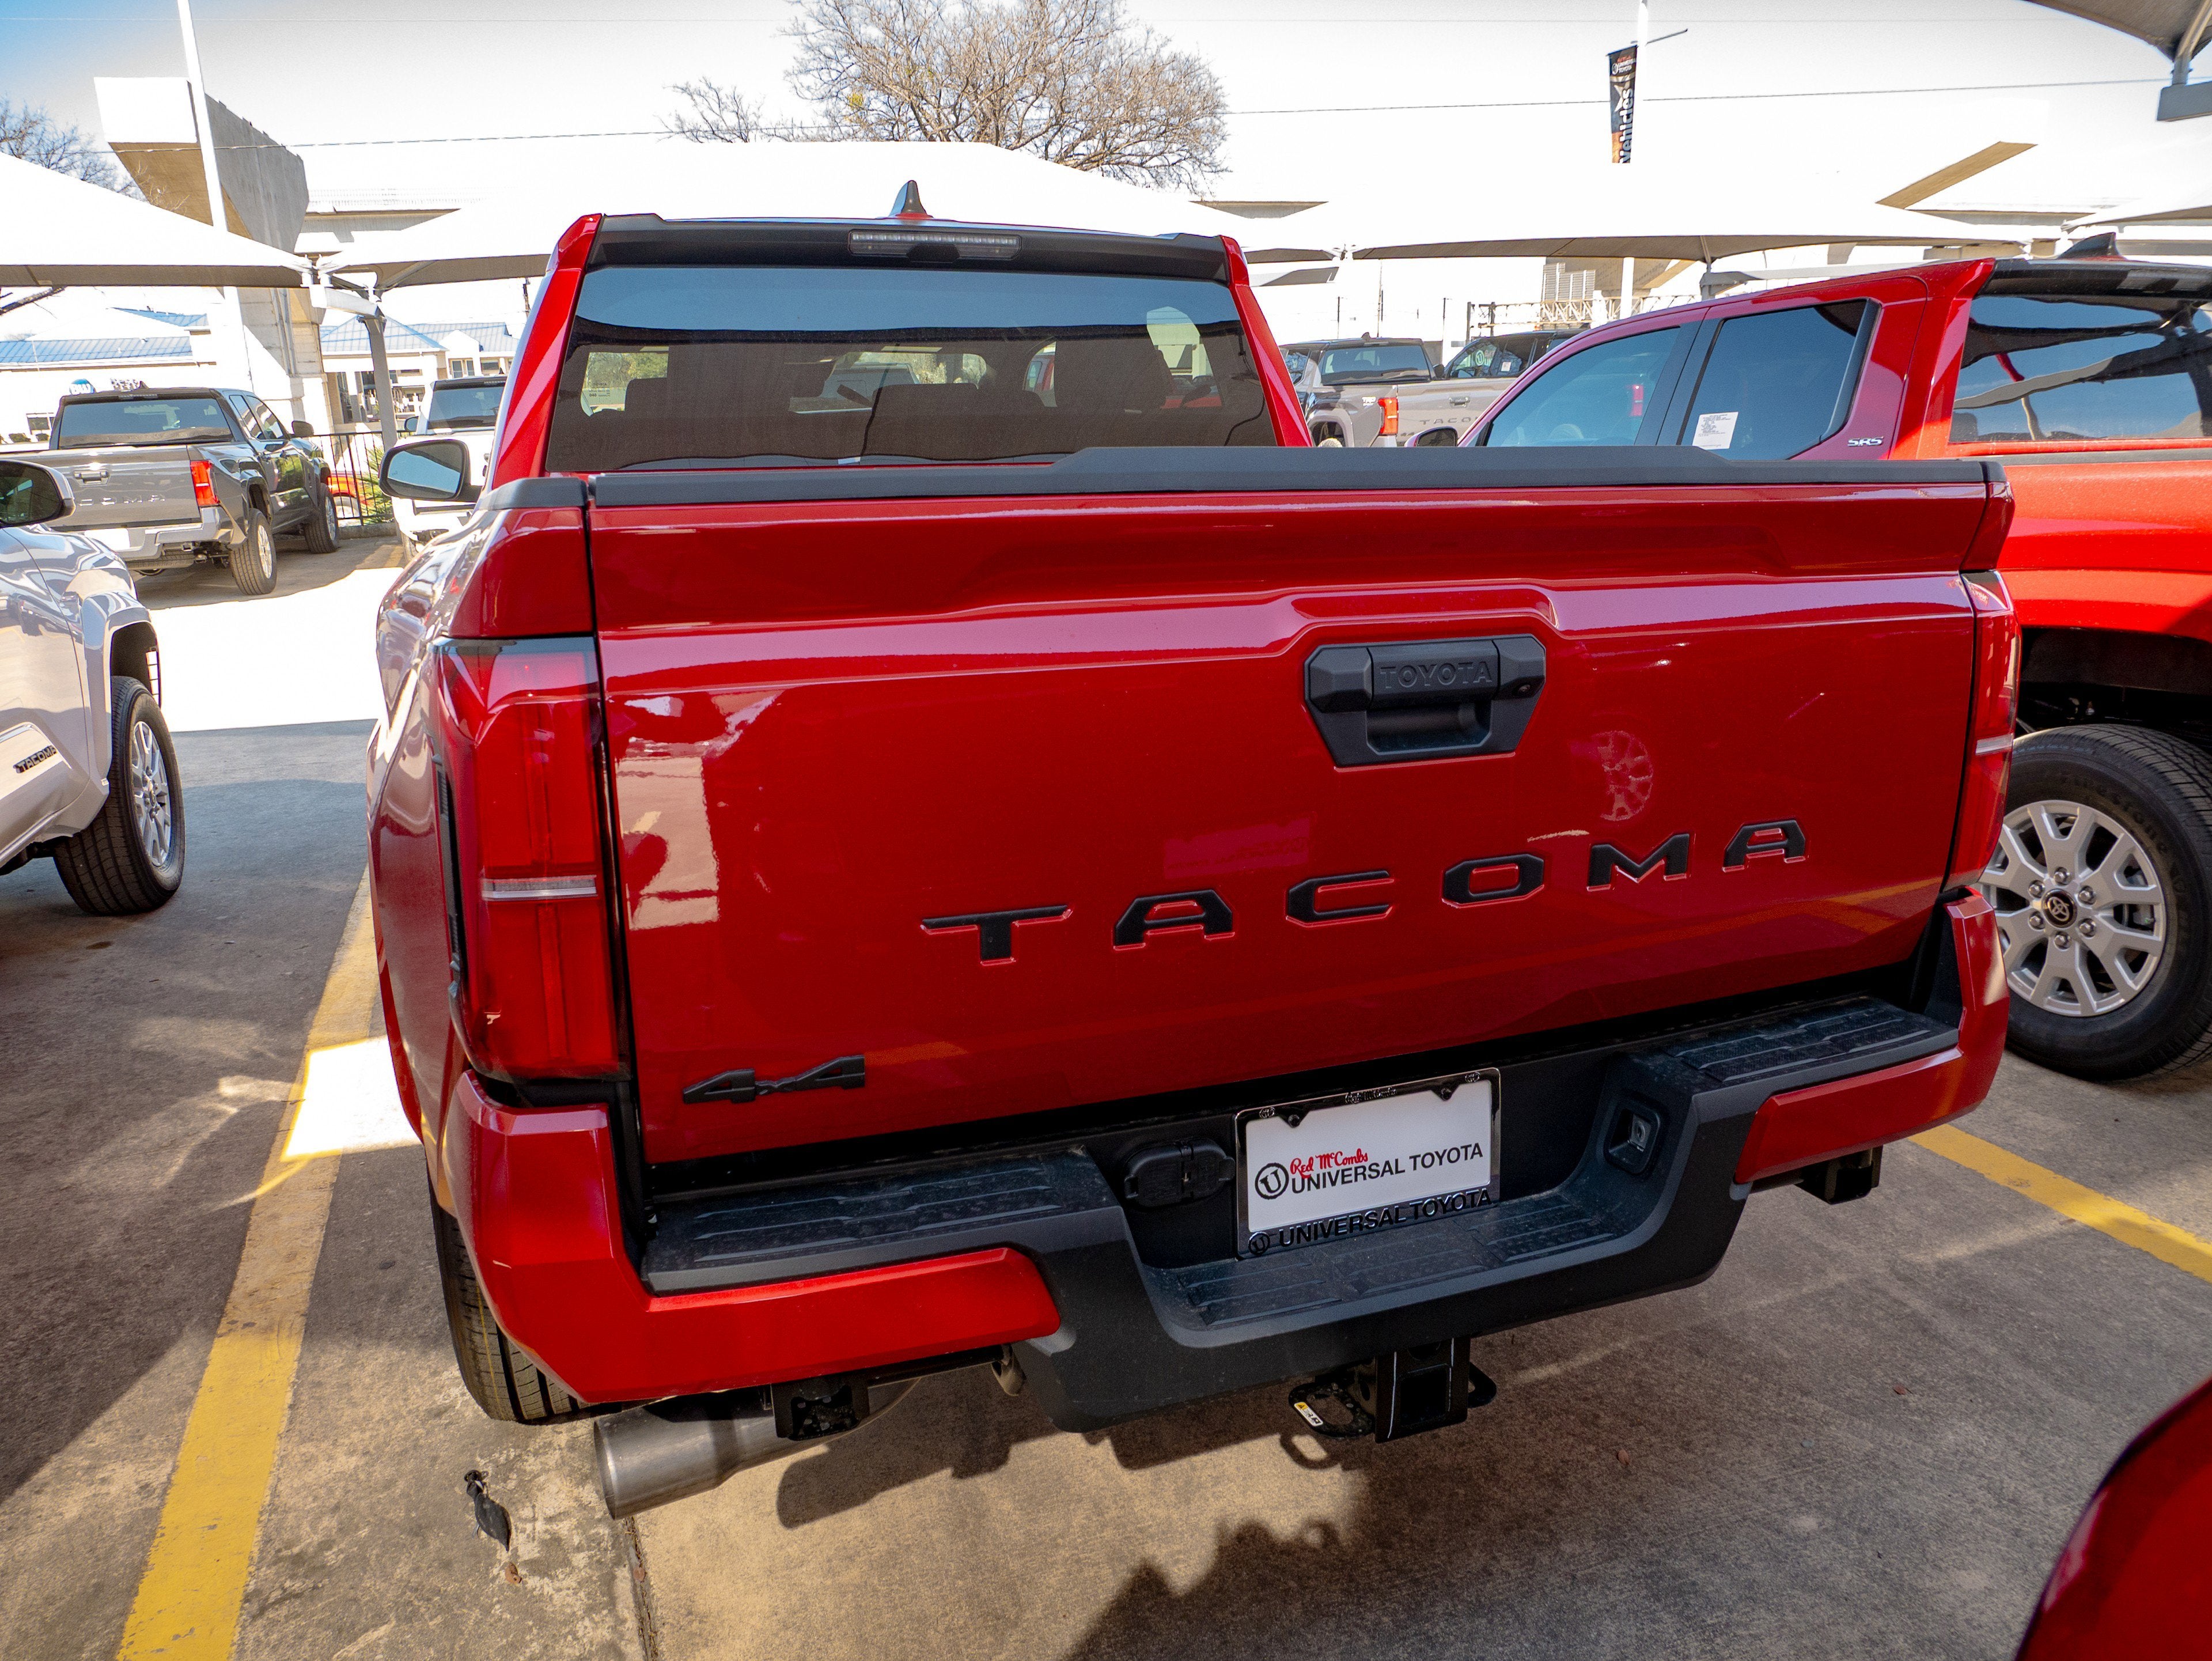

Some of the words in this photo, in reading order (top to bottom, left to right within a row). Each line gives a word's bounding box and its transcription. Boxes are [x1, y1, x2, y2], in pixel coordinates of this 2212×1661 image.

[1419, 417, 1478, 425] TACO
[1380, 661, 1493, 688] TOYOTA
[13, 745, 58, 773] TACOMA
[921, 818, 1807, 966] TACOMA
[1290, 1157, 1314, 1179] Red
[1315, 1148, 1369, 1169] McCombs
[1291, 1158, 1406, 1194] UNIVERSAL
[1409, 1142, 1483, 1171] TOYOTA
[1278, 1205, 1407, 1247] UNIVERSAL
[1409, 1187, 1493, 1220] TOYOTA
